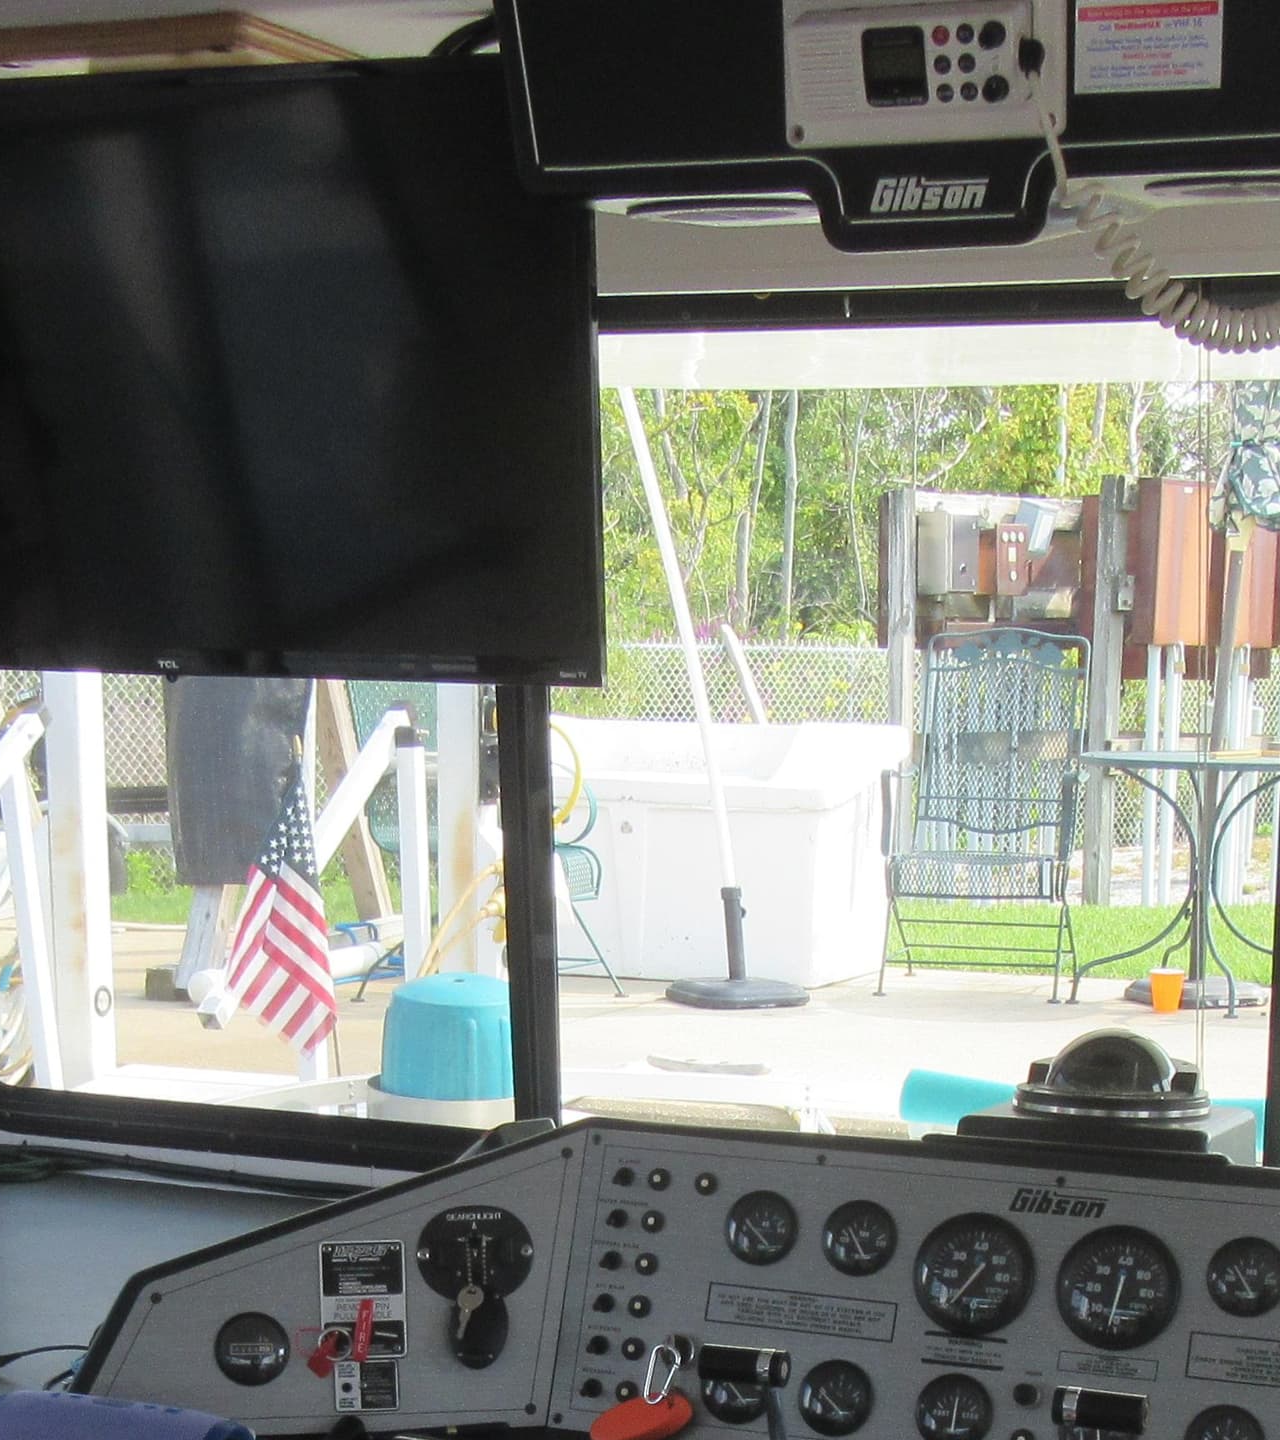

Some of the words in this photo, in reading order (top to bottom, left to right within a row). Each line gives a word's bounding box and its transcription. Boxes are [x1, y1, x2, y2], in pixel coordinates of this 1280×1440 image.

[870, 176, 990, 213] Gibson
[158, 660, 180, 669] TCL
[1009, 1188, 1108, 1218] Gibson
[358, 1310, 369, 1353] FIRE
